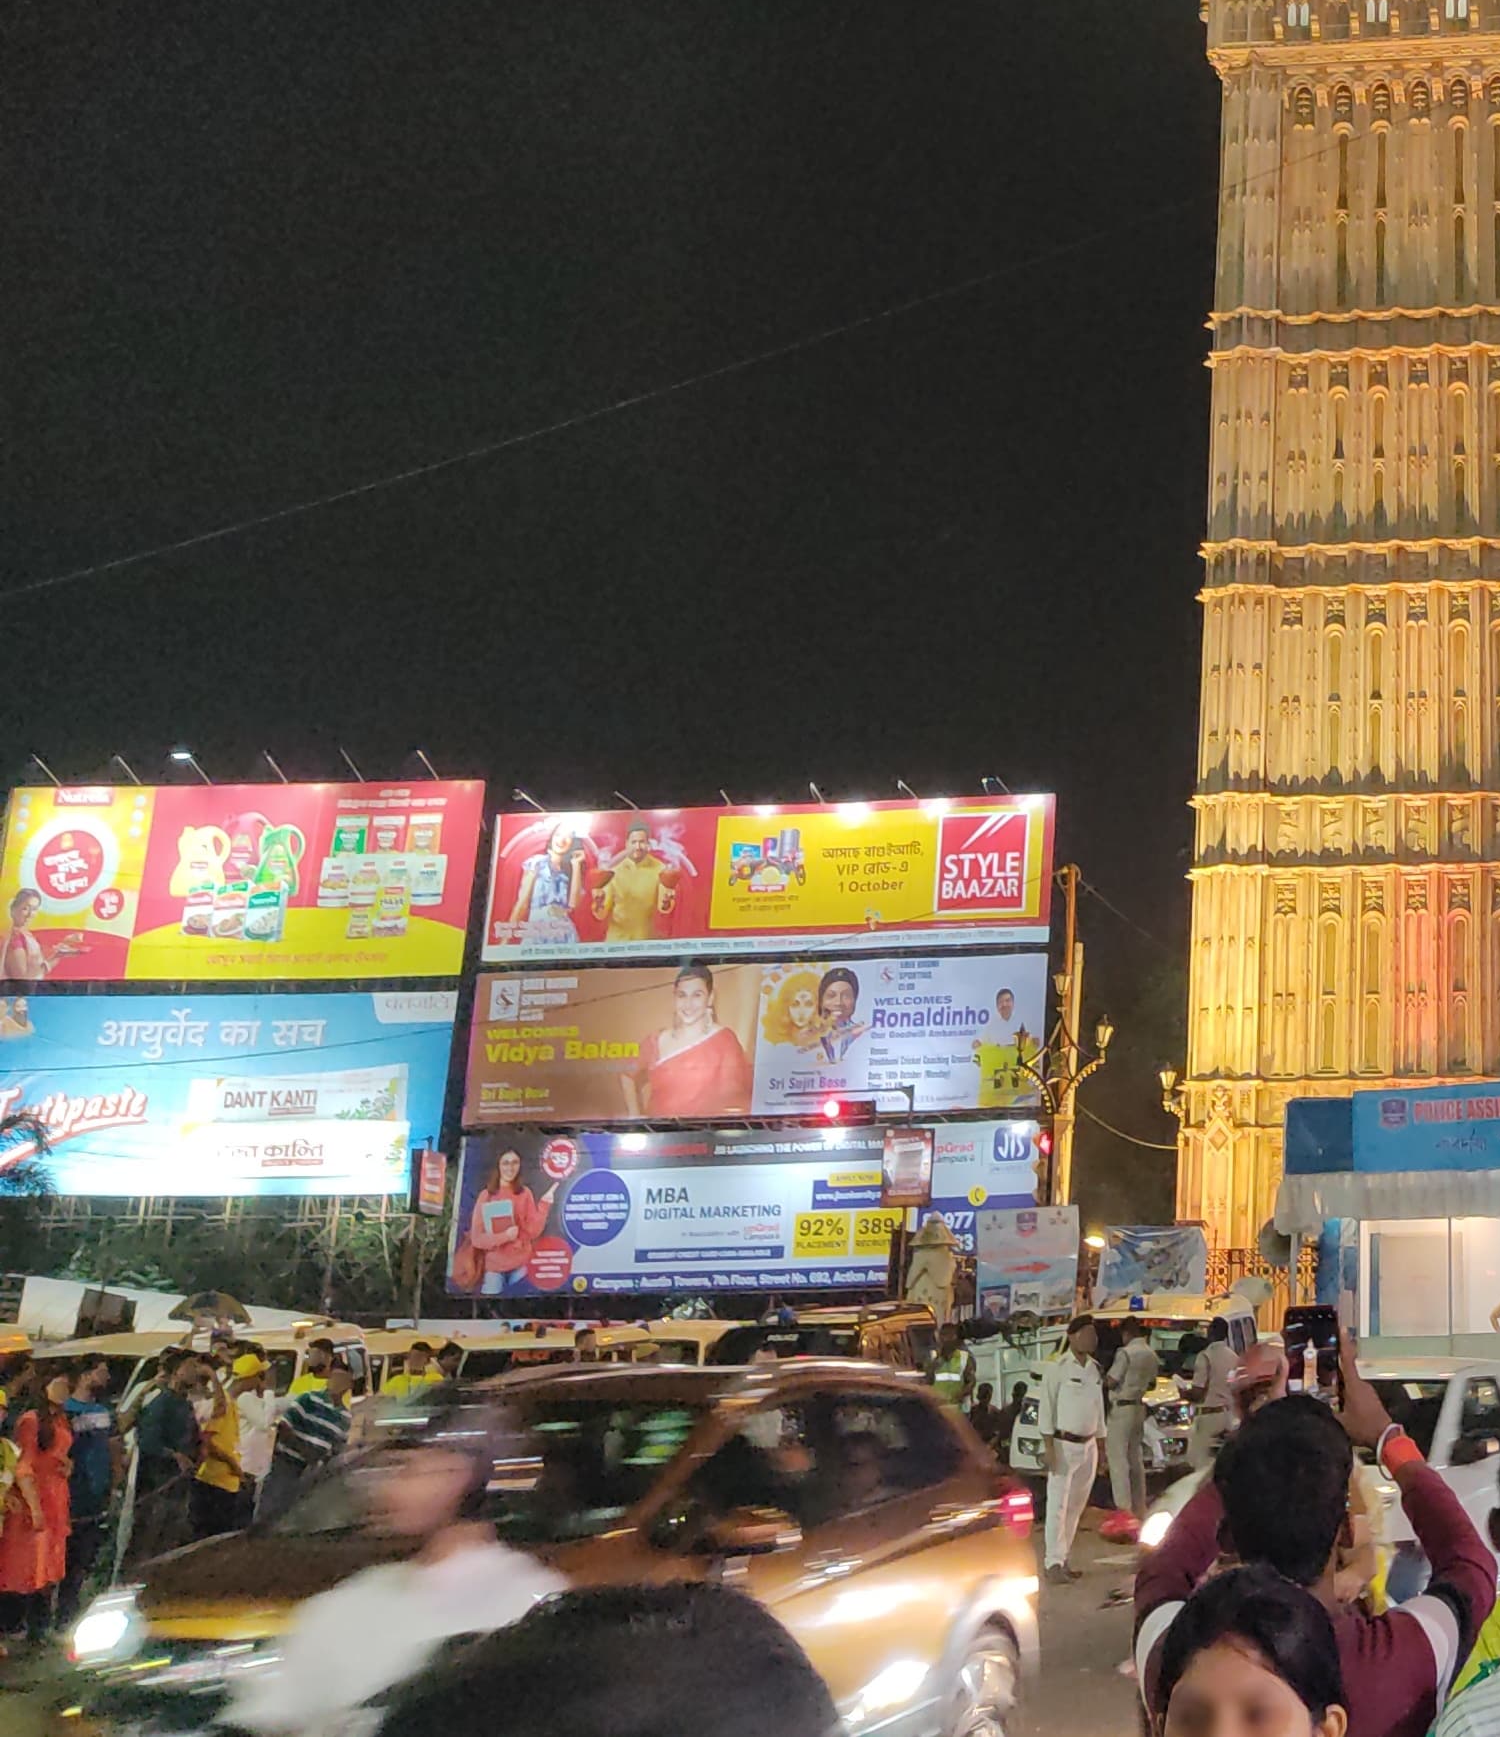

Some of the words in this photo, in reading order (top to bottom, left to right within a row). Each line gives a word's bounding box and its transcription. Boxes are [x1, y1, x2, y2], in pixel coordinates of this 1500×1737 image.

[837, 863, 859, 876] VIP
[944, 852, 1020, 879] STYLE
[848, 879, 904, 893] October
[941, 878, 1019, 899] BAAZAR
[873, 995, 953, 1007] WELCOMES
[872, 1006, 991, 1029] Ronaldinho
[98, 1009, 208, 1058] आयुर्वेद
[220, 1019, 261, 1046] का
[272, 1019, 326, 1046] सच
[485, 1041, 555, 1067] Vidya
[564, 1040, 640, 1060] Balan
[224, 1091, 267, 1108] DANT
[271, 1090, 318, 1107] KANTI
[1415, 1100, 1463, 1122] POLICE
[997, 1130, 1025, 1159] JIS
[646, 1186, 690, 1205] MBA
[644, 1207, 696, 1221] DIGITAL
[699, 1204, 782, 1219] MARKETING
[799, 1217, 844, 1237] 92%
